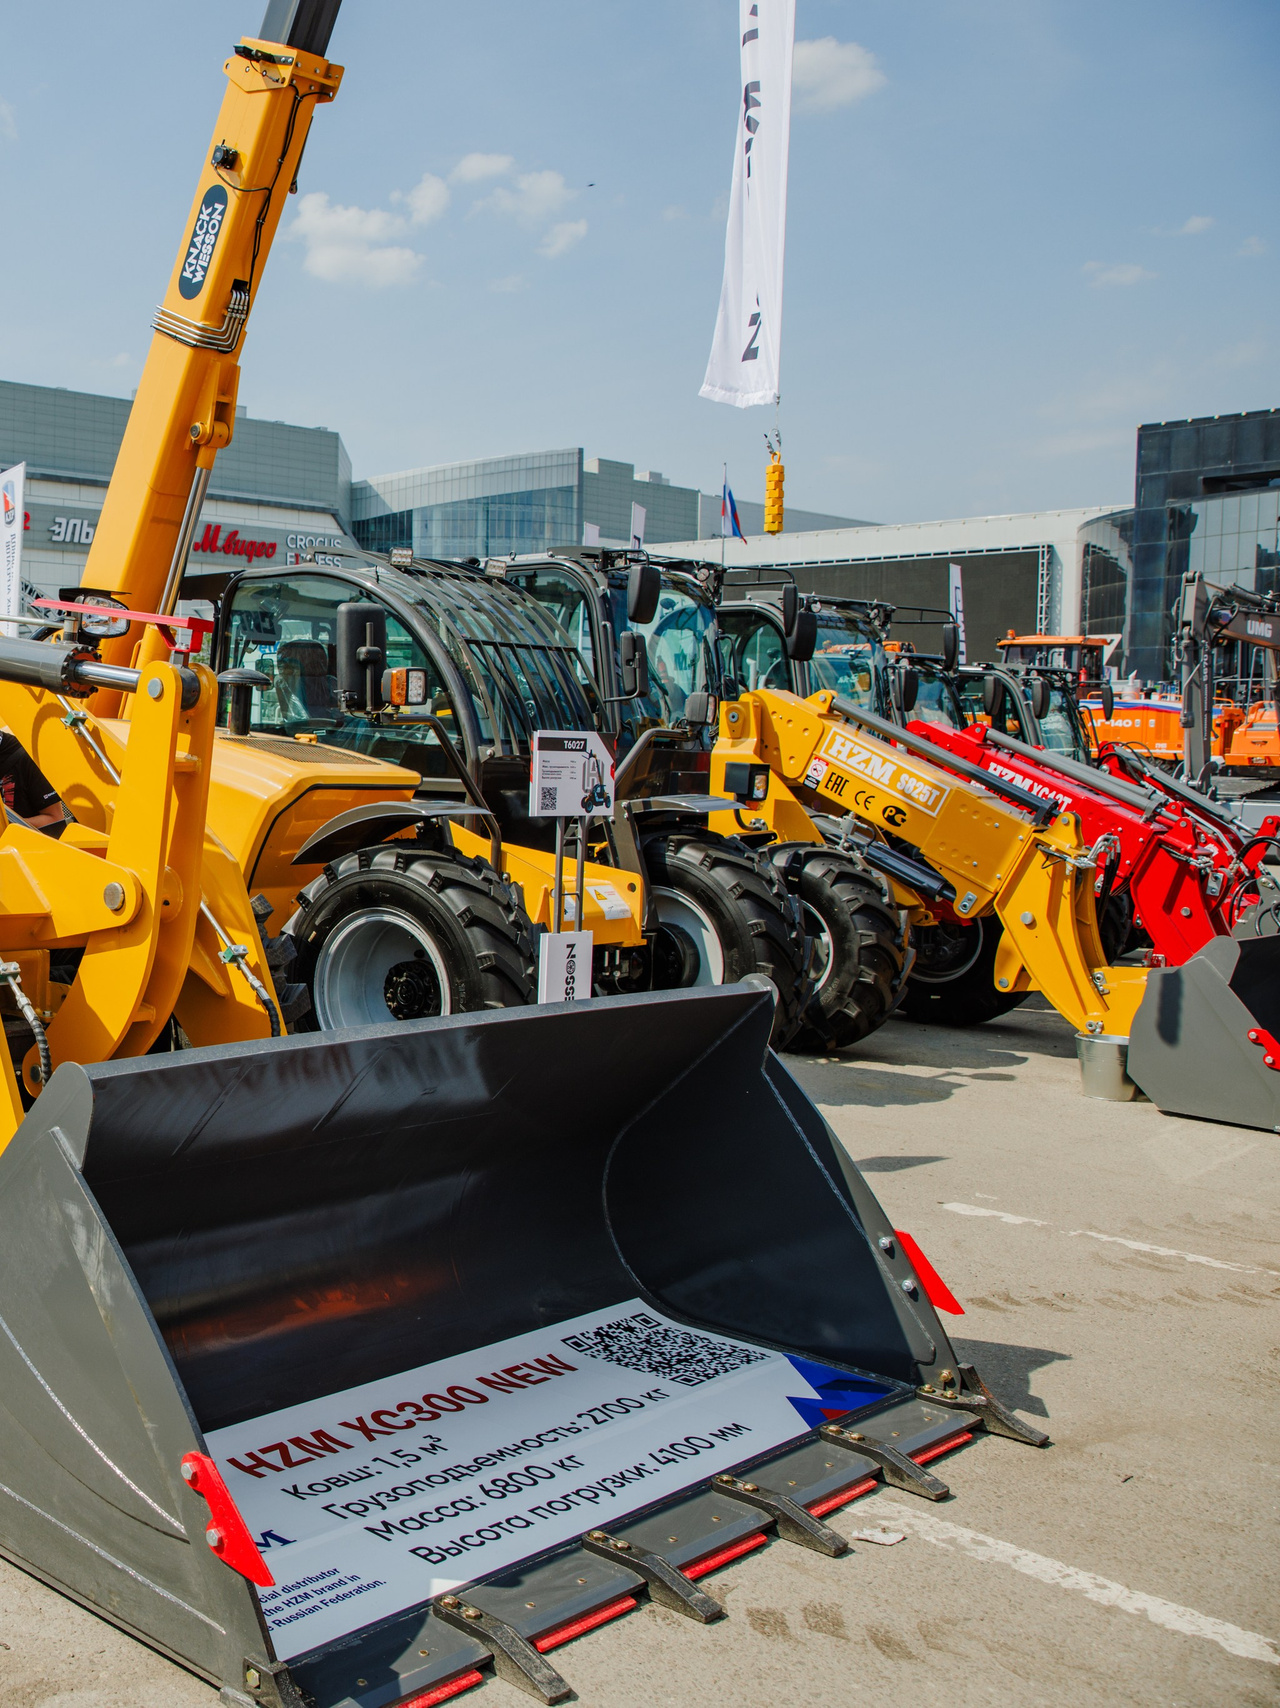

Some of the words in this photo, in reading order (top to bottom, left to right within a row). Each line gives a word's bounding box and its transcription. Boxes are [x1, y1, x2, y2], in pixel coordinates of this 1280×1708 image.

[182, 203, 213, 279] KNACK
[1247, 619, 1273, 638] UMG
[563, 740, 585, 750] T6027
[828, 734, 897, 785] HZM
[896, 773, 941, 806] S825T
[226, 1428, 355, 1479] HZM
[337, 1385, 490, 1442] XC300
[475, 1353, 579, 1394] NEW
[280, 1465, 383, 1500] Ковш:
[371, 1449, 422, 1469] 1,5
[321, 1421, 590, 1520] Грузоподъемность:
[576, 1396, 646, 1426] 2700
[640, 1388, 671, 1402] кг
[363, 1495, 487, 1542] Масса:
[479, 1464, 556, 1500] 6800
[552, 1454, 585, 1472] кг
[408, 1514, 530, 1565] Высота
[528, 1462, 661, 1520] погрузки:
[648, 1435, 716, 1467] 4100
[709, 1422, 753, 1442] мм
[271, 1604, 323, 1628] Russian
[319, 1580, 387, 1608] Federation.
[281, 1568, 341, 1594] distributor
[282, 1591, 314, 1608] HZM
[311, 1578, 348, 1597] brand
[347, 1573, 361, 1583] in
